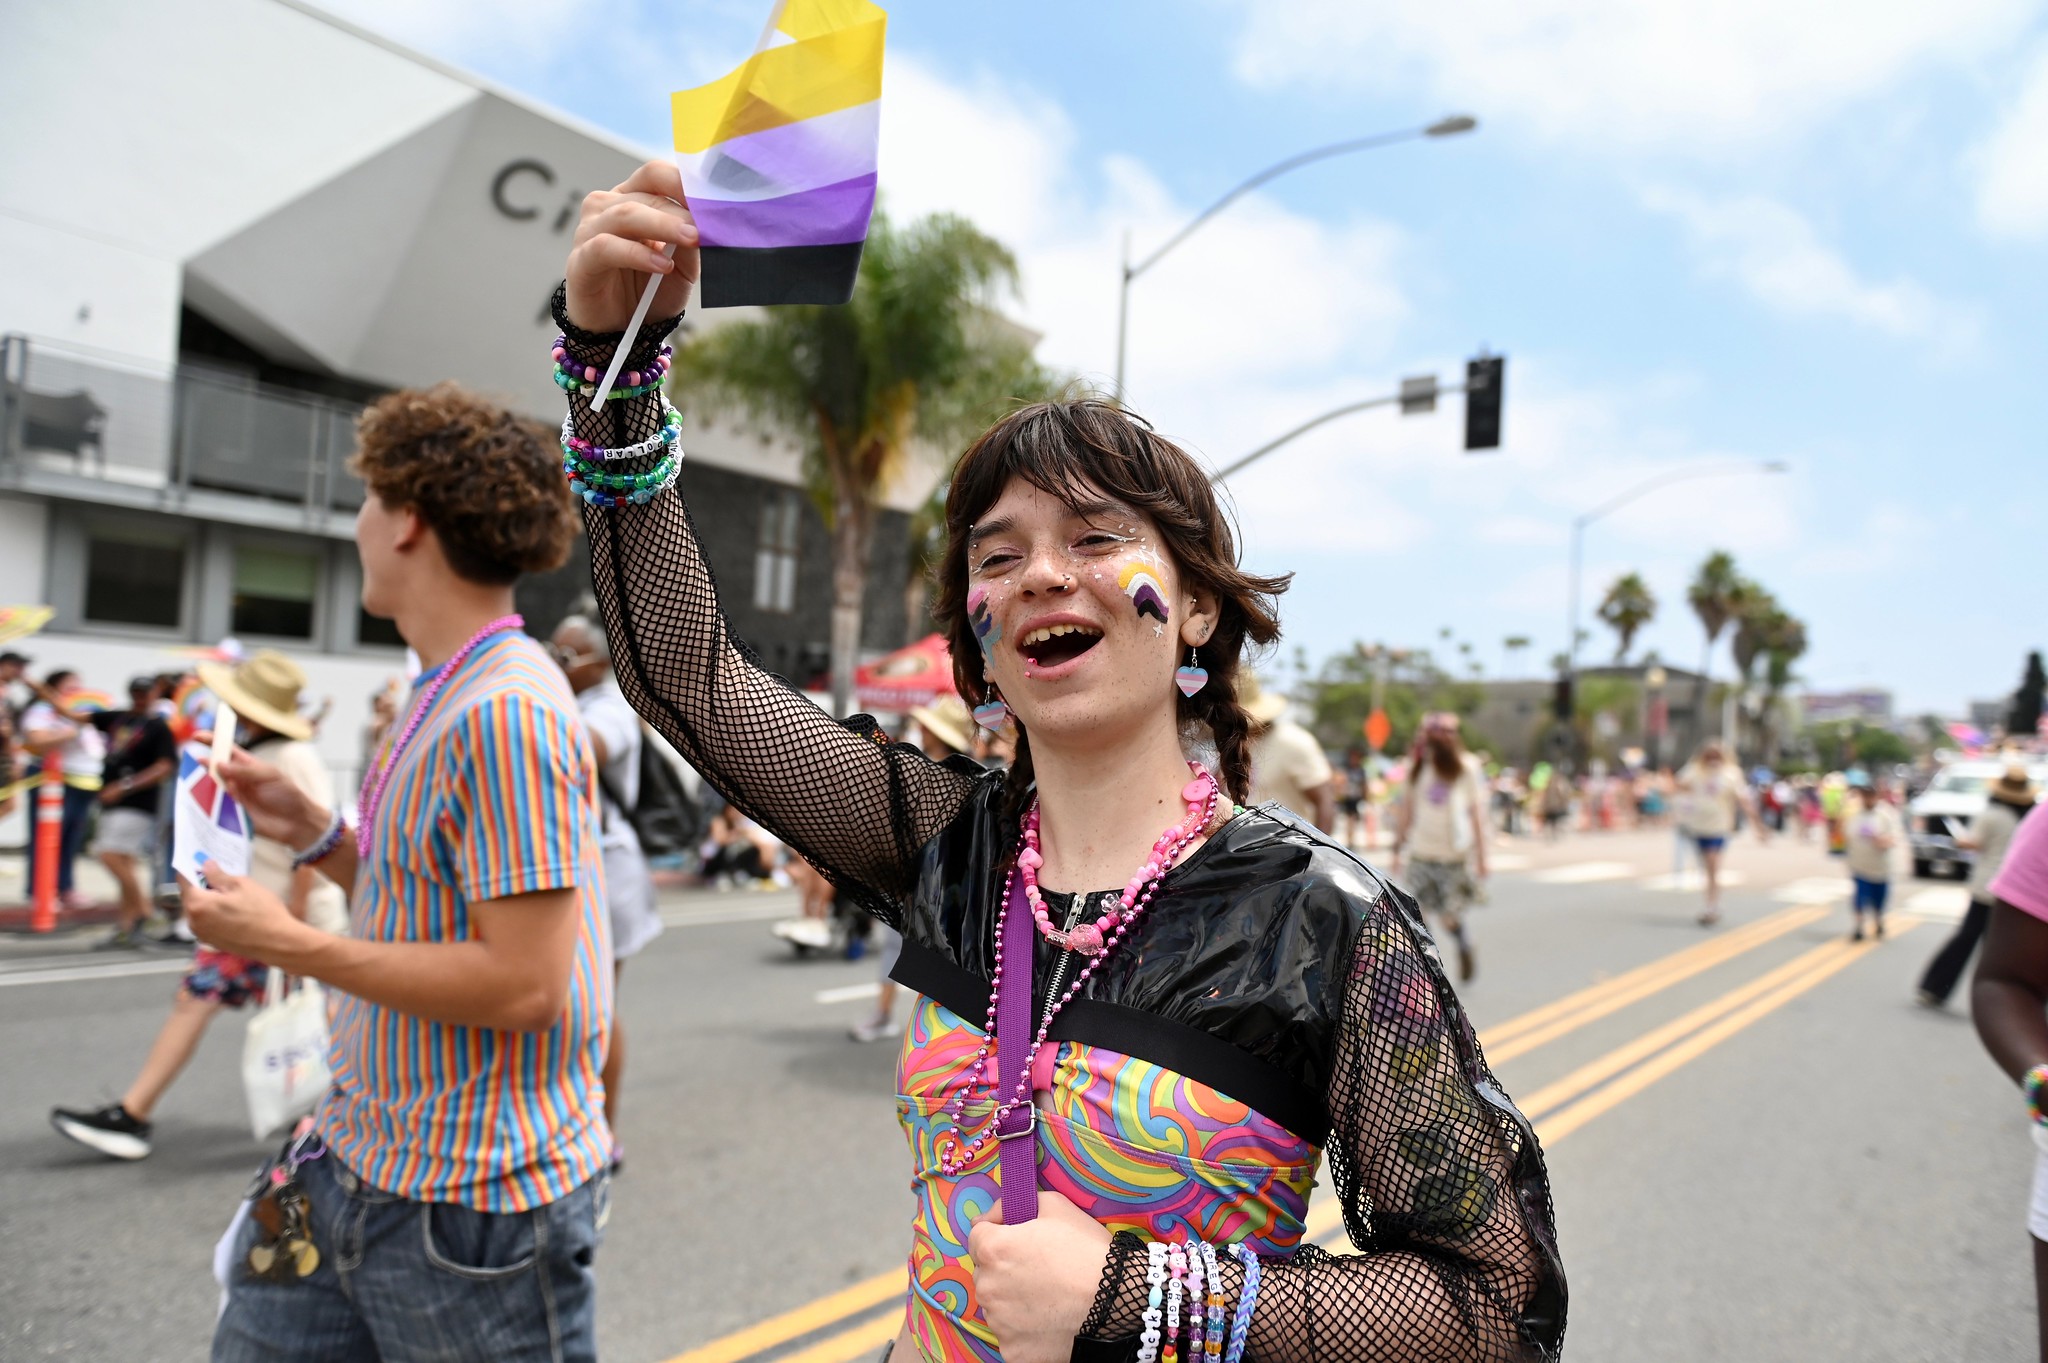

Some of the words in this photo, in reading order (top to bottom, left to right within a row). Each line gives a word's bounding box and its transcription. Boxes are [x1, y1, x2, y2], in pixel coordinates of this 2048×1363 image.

[490, 157, 584, 234] Ci
[605, 438, 664, 459] DOLLAR
[1168, 1280, 1182, 1325] ORGY
